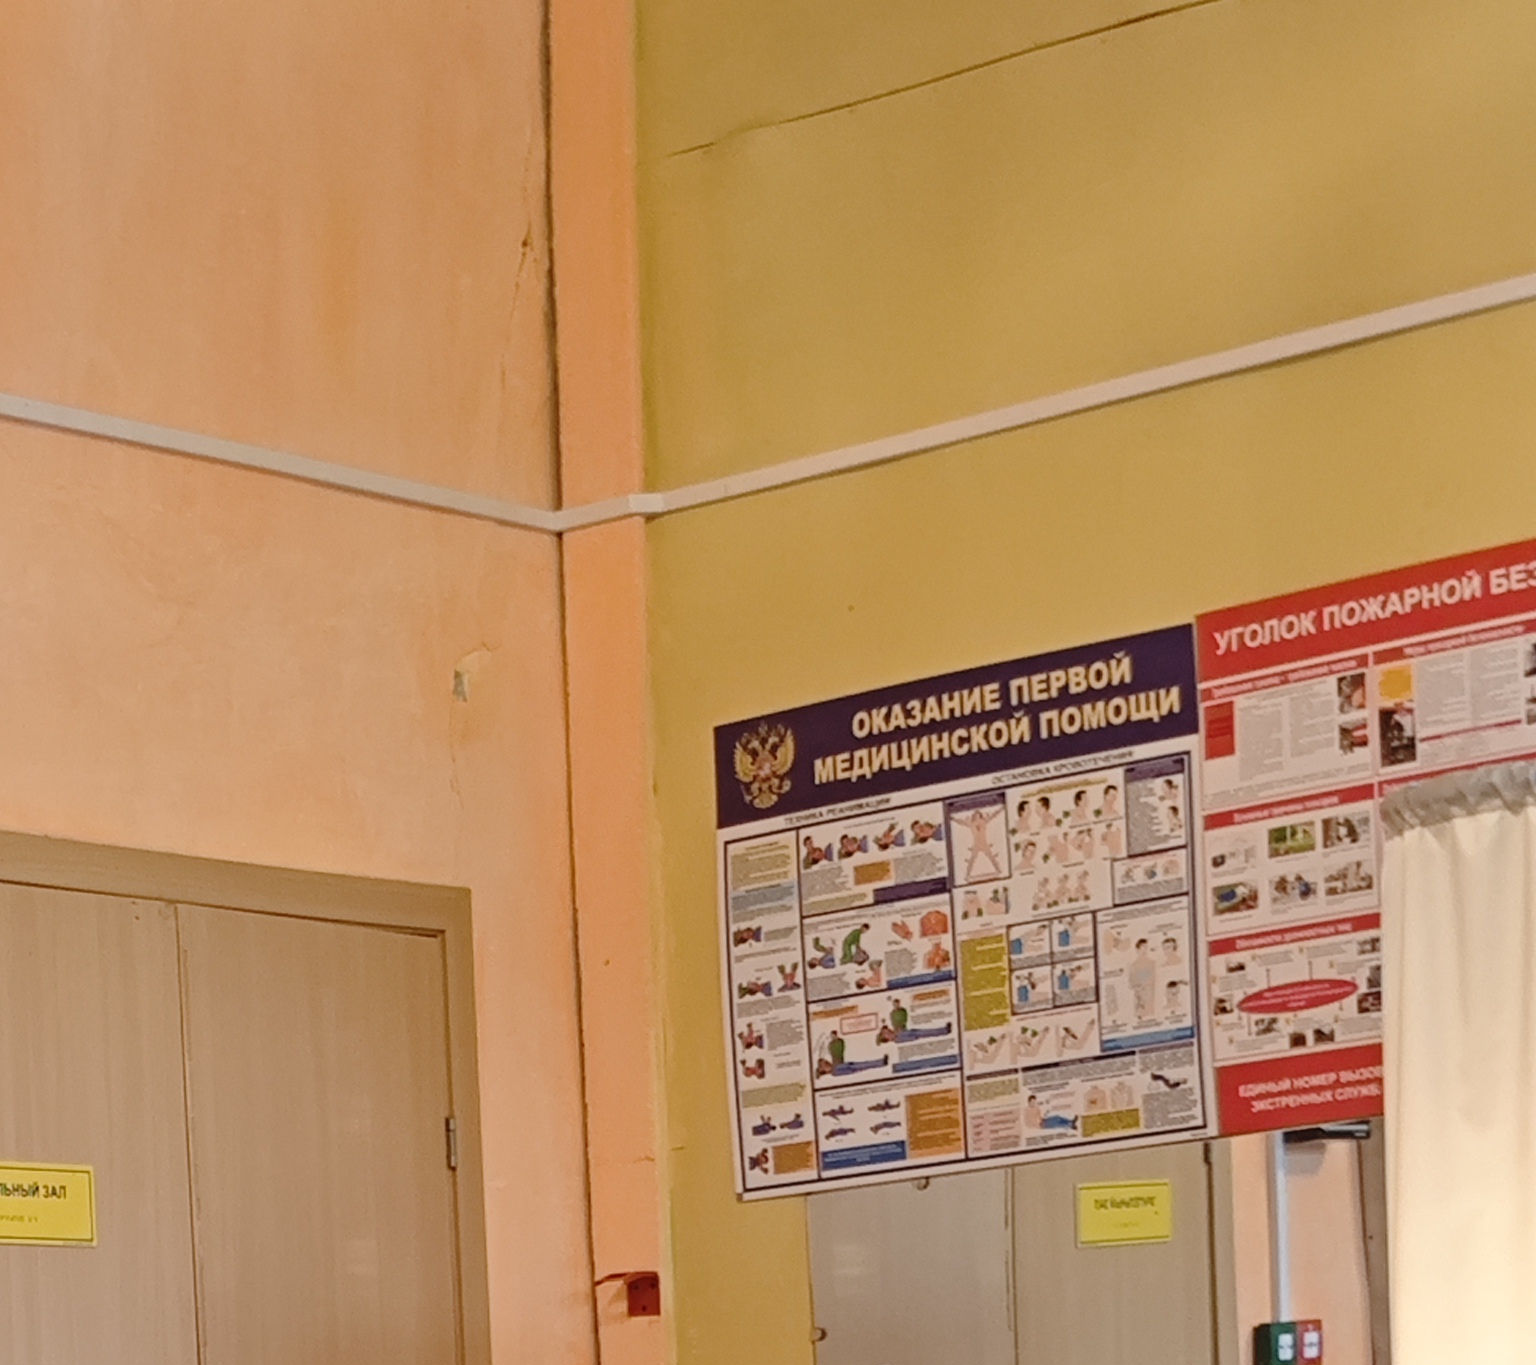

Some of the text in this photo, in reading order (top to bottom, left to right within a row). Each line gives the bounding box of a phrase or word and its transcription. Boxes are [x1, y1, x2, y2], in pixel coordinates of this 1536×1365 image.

[1213, 611, 1317, 656] УГОЛОК
[1322, 570, 1483, 631] ПОЖАРНОЙ
[851, 650, 1133, 739] ОКАЗАНИЕ ПЕРВОЙ
[814, 686, 1182, 785] МЕДИЦИНСКОЙ ПОМОЩИ
[1238, 1077, 1292, 1098] ЕДИНЫЙ
[1292, 1072, 1337, 1089] НОМЕР
[1250, 1090, 1334, 1113] ЭКСТРЕННЫХ
[42, 1184, 67, 1199] ЗАЛ
